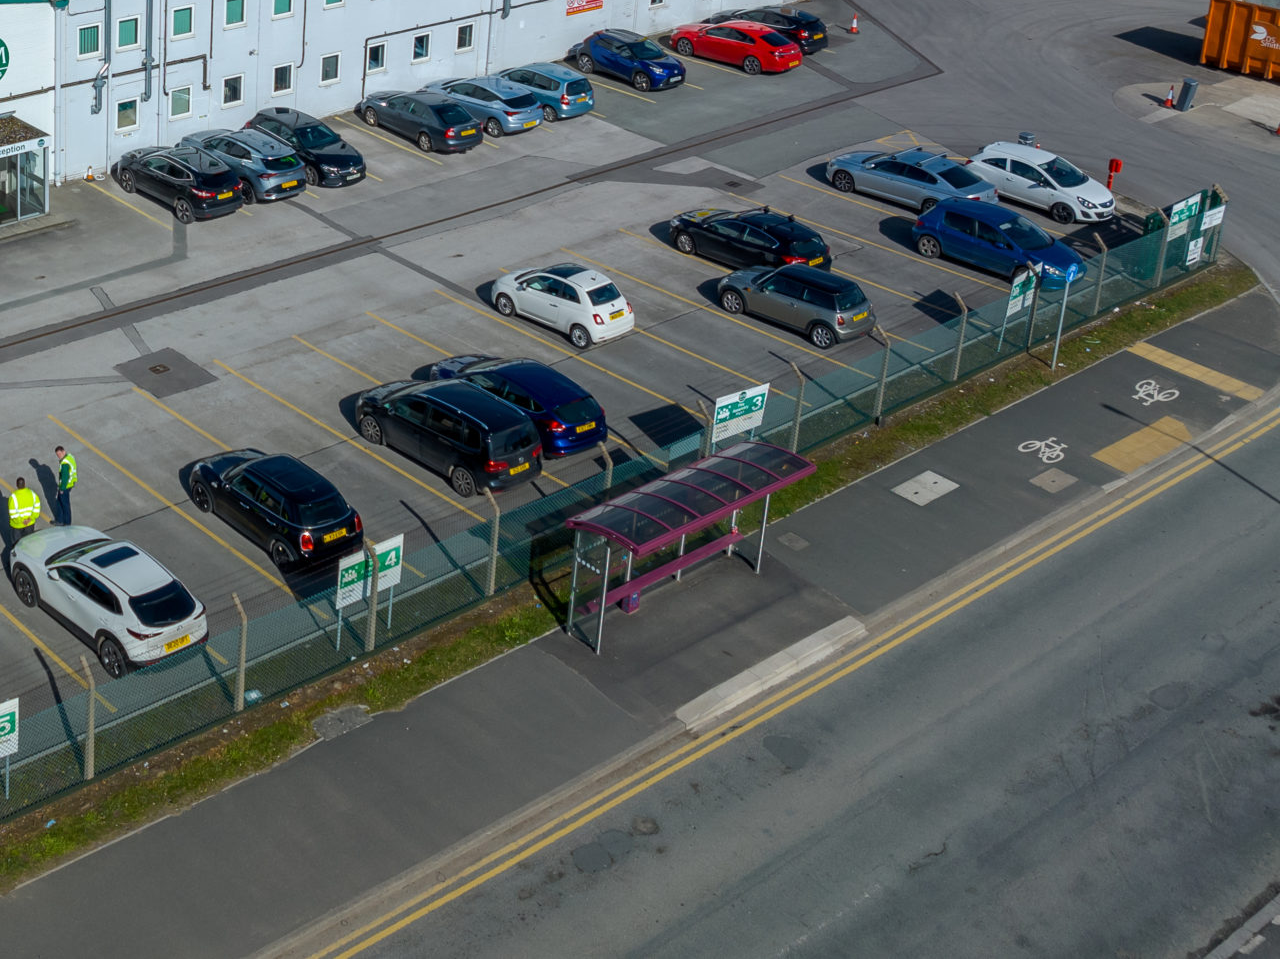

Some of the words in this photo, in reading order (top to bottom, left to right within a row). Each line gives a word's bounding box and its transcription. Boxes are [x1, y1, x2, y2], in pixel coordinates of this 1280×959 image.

[1266, 36, 1276, 44] DS
[752, 396, 762, 410] 3
[384, 550, 397, 566] 4
